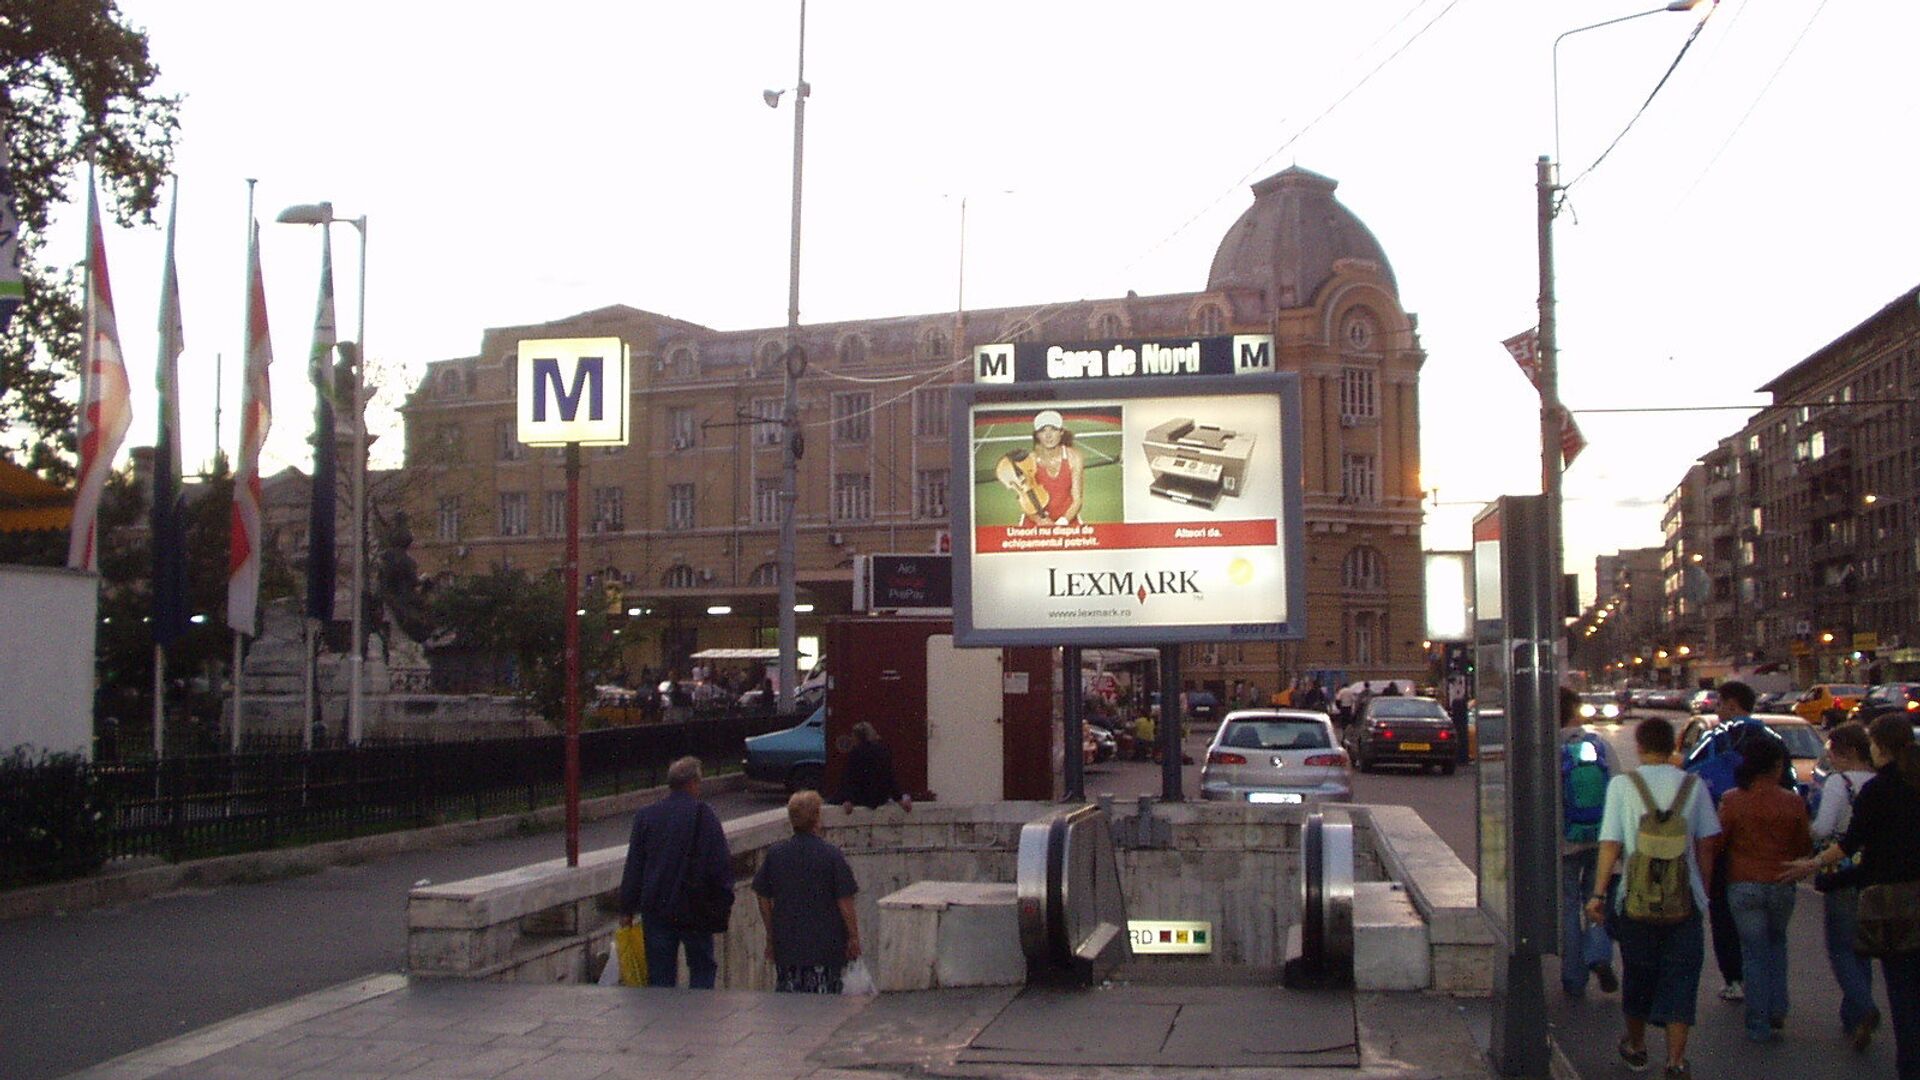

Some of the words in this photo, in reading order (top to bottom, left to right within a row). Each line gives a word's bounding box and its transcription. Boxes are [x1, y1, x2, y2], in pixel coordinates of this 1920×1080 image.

[980, 353, 1007, 377] M
[1047, 346, 1103, 379] Gara
[1107, 345, 1137, 377] de
[1141, 342, 1200, 376] Nord
[1240, 343, 1270, 368] M
[532, 357, 604, 422] M
[1048, 568, 1201, 605] LEXMARK
